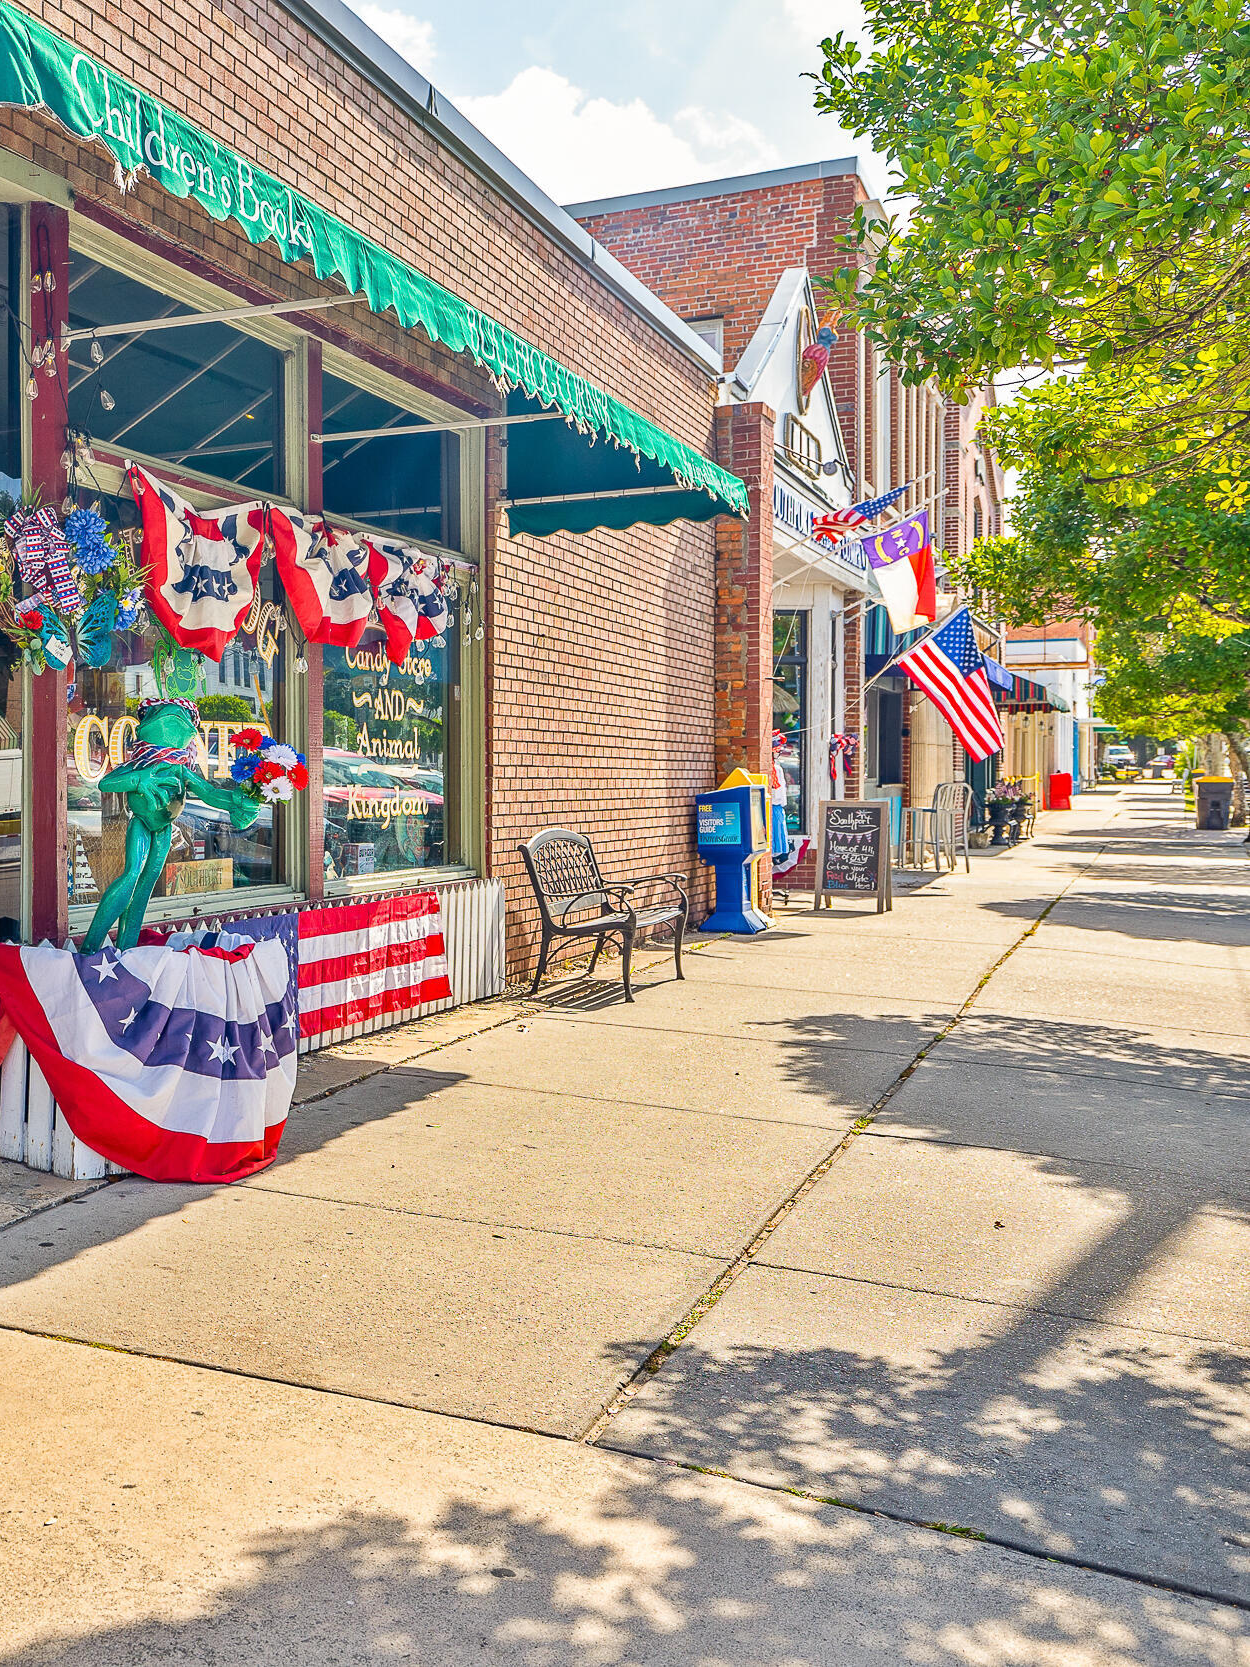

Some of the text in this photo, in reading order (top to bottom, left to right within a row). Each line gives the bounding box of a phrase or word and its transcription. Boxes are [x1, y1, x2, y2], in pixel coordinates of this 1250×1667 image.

[70, 53, 232, 209] Children's
[374, 688, 405, 721] AND
[74, 714, 273, 783] CONE
[356, 722, 422, 760] Animal
[347, 784, 430, 830] Kingdom
[698, 804, 713, 812] FREE
[699, 818, 724, 826] VISITORS
[699, 826, 717, 834] GUIDE
